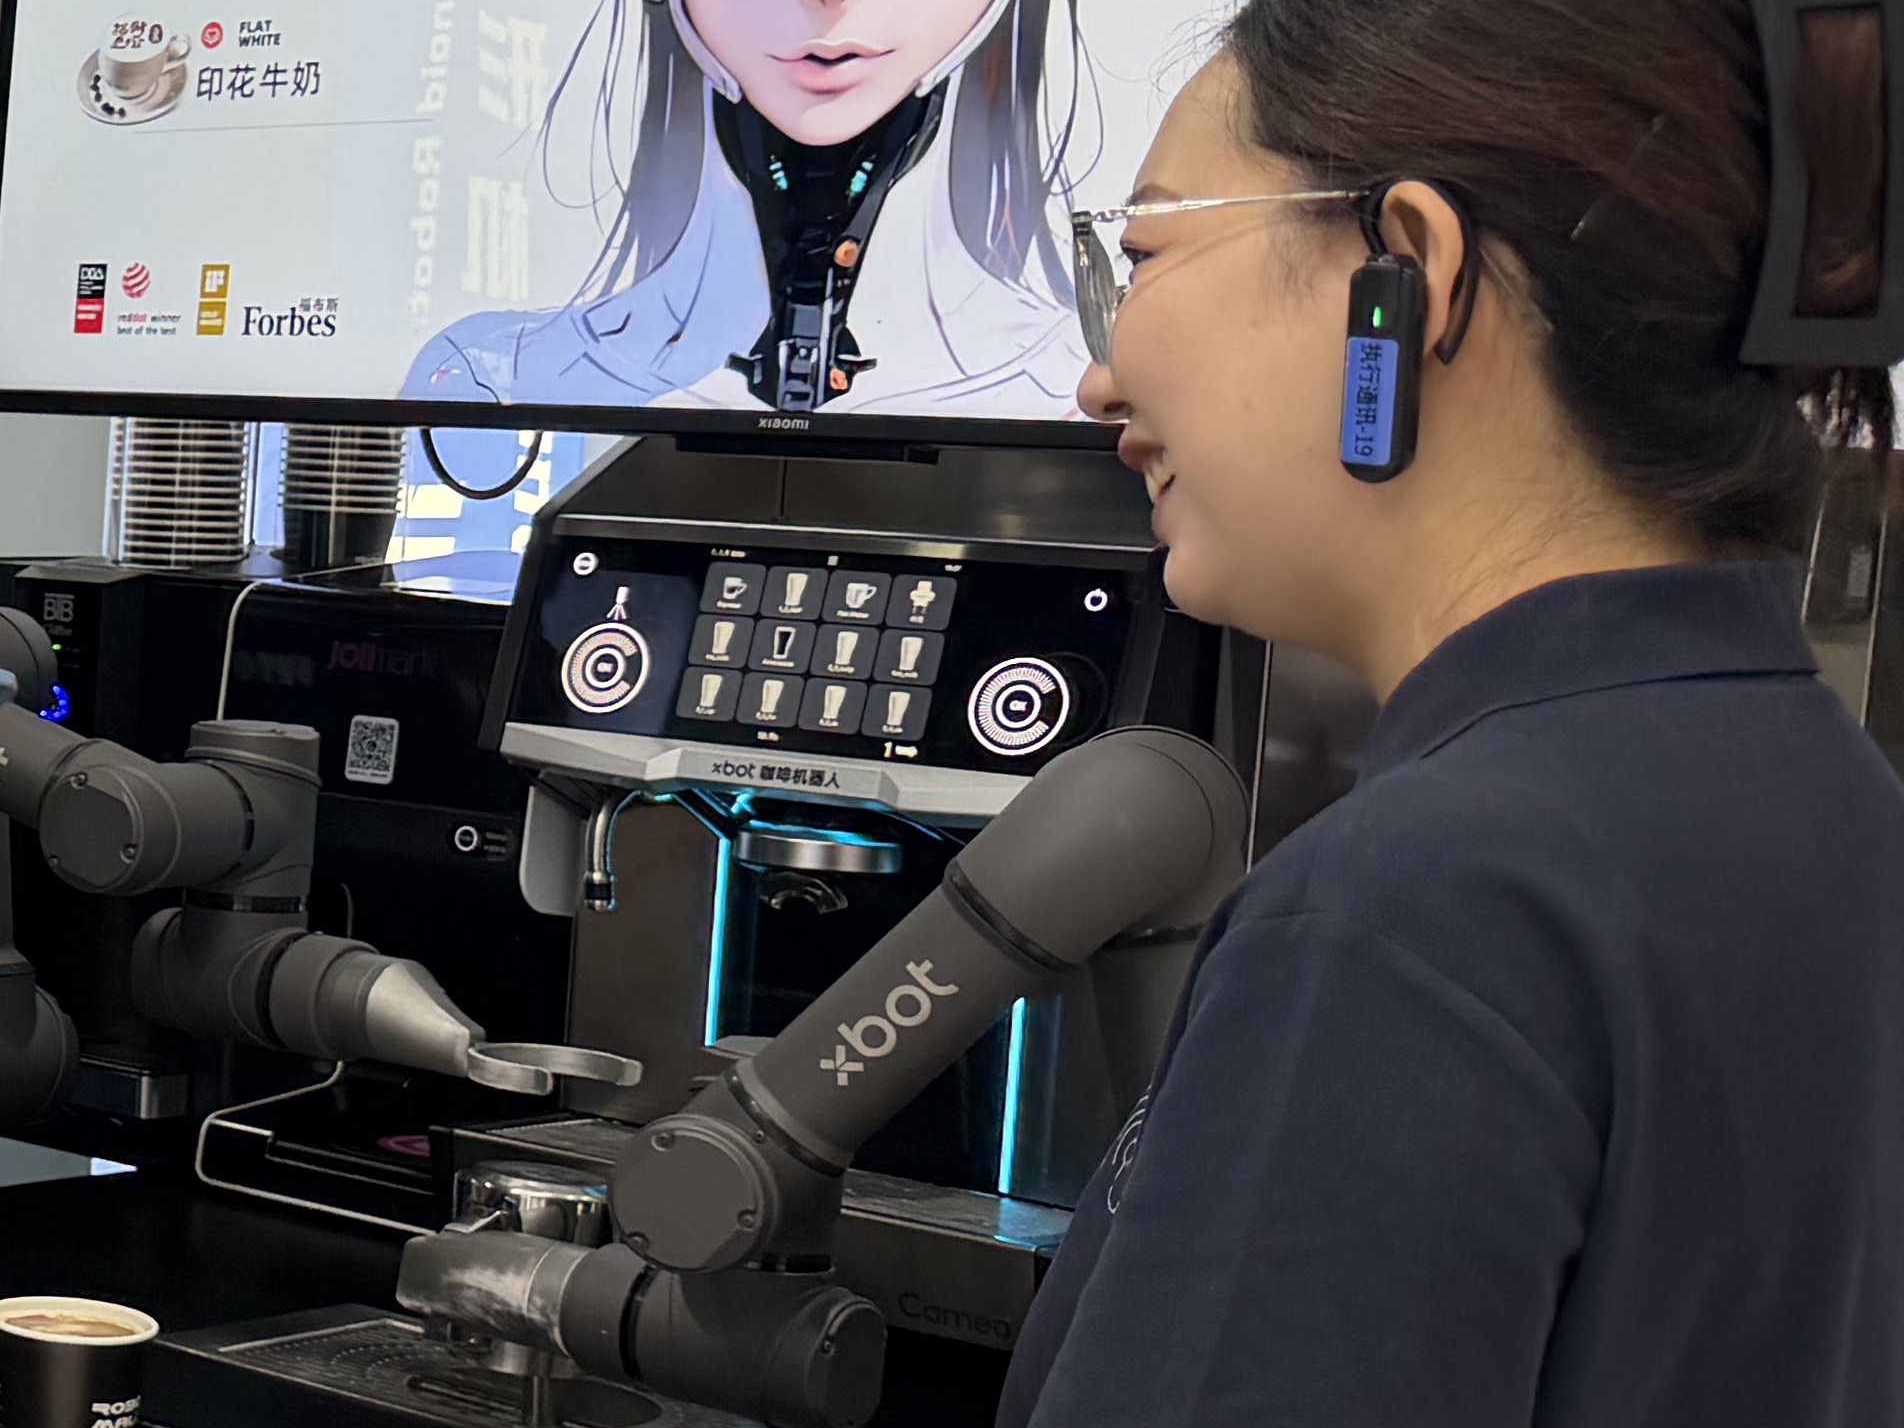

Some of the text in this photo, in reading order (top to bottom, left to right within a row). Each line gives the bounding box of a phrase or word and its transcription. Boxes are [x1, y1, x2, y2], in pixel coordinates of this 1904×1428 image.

[239, 20, 272, 33] FLAT
[238, 33, 281, 47] WHITE
[196, 61, 321, 101] 印花牛奶
[241, 306, 336, 337] Forbes
[712, 760, 756, 779] xbot
[820, 959, 959, 1086] xbot
